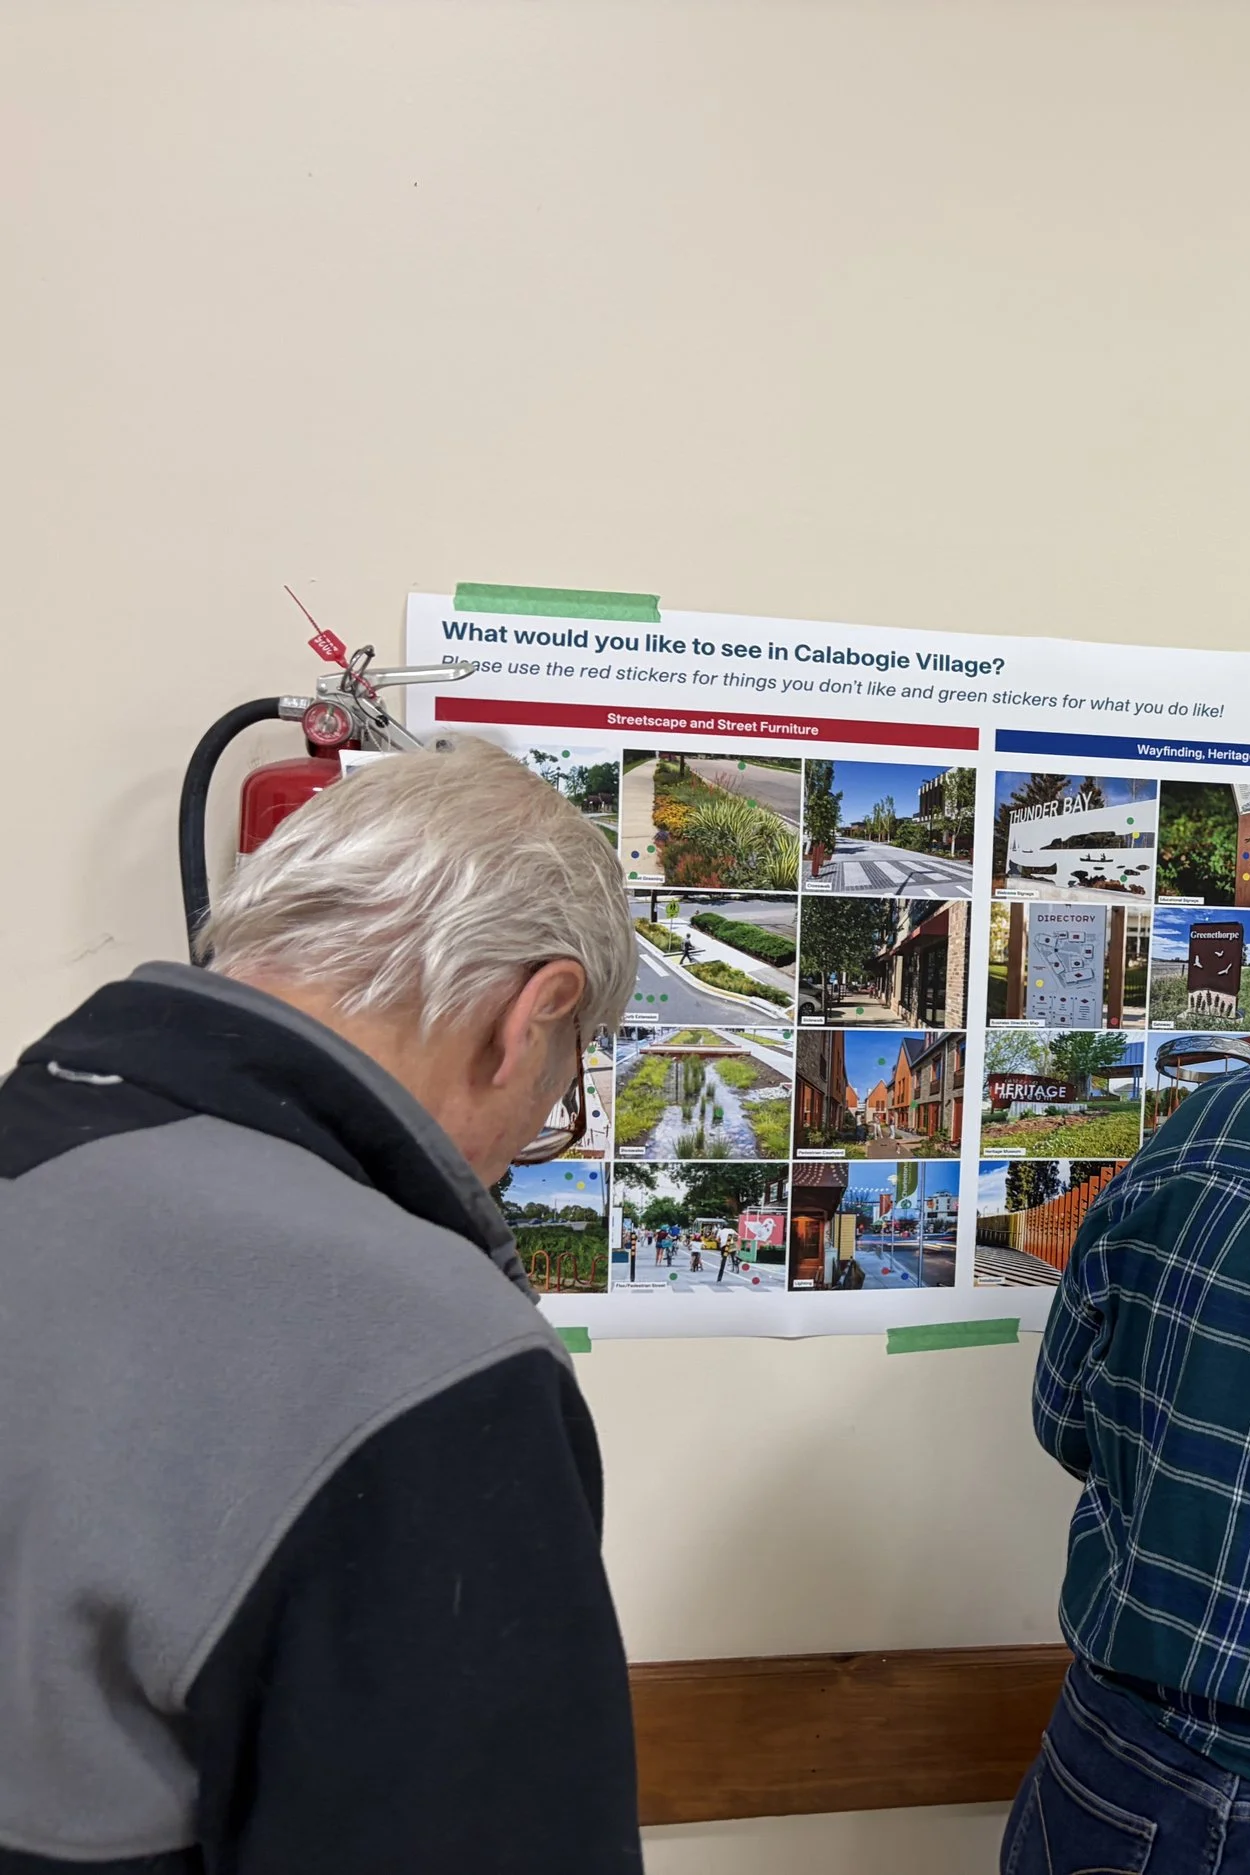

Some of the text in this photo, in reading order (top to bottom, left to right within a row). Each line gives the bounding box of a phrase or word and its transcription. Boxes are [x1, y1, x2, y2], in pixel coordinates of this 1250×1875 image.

[442, 621, 1004, 677] What would you like to see in Calabogie Village?
[508, 663, 540, 673] use
[547, 663, 574, 677] the
[580, 665, 611, 679] red
[616, 667, 686, 683] stickers
[693, 670, 718, 685] for
[724, 673, 776, 691] things
[781, 680, 813, 693] you
[819, 679, 862, 694] don't
[867, 681, 896, 696] like
[901, 686, 934, 699] and
[938, 690, 987, 703] green
[992, 691, 1057, 707] stickers
[1063, 694, 1086, 708] for
[1091, 697, 1130, 711] what
[1134, 703, 1163, 715] you
[1168, 702, 1188, 715] do
[1193, 703, 1224, 717] like!
[608, 713, 818, 735] Streetscape and Street Furniture
[1138, 745, 1205, 760] Wayfinding,
[1009, 791, 1093, 824] THUNDER BAY
[1037, 914, 1096, 922] DIRECTORY
[1190, 930, 1240, 941] Greenethorpe
[994, 1082, 1066, 1098] HERITAGE
